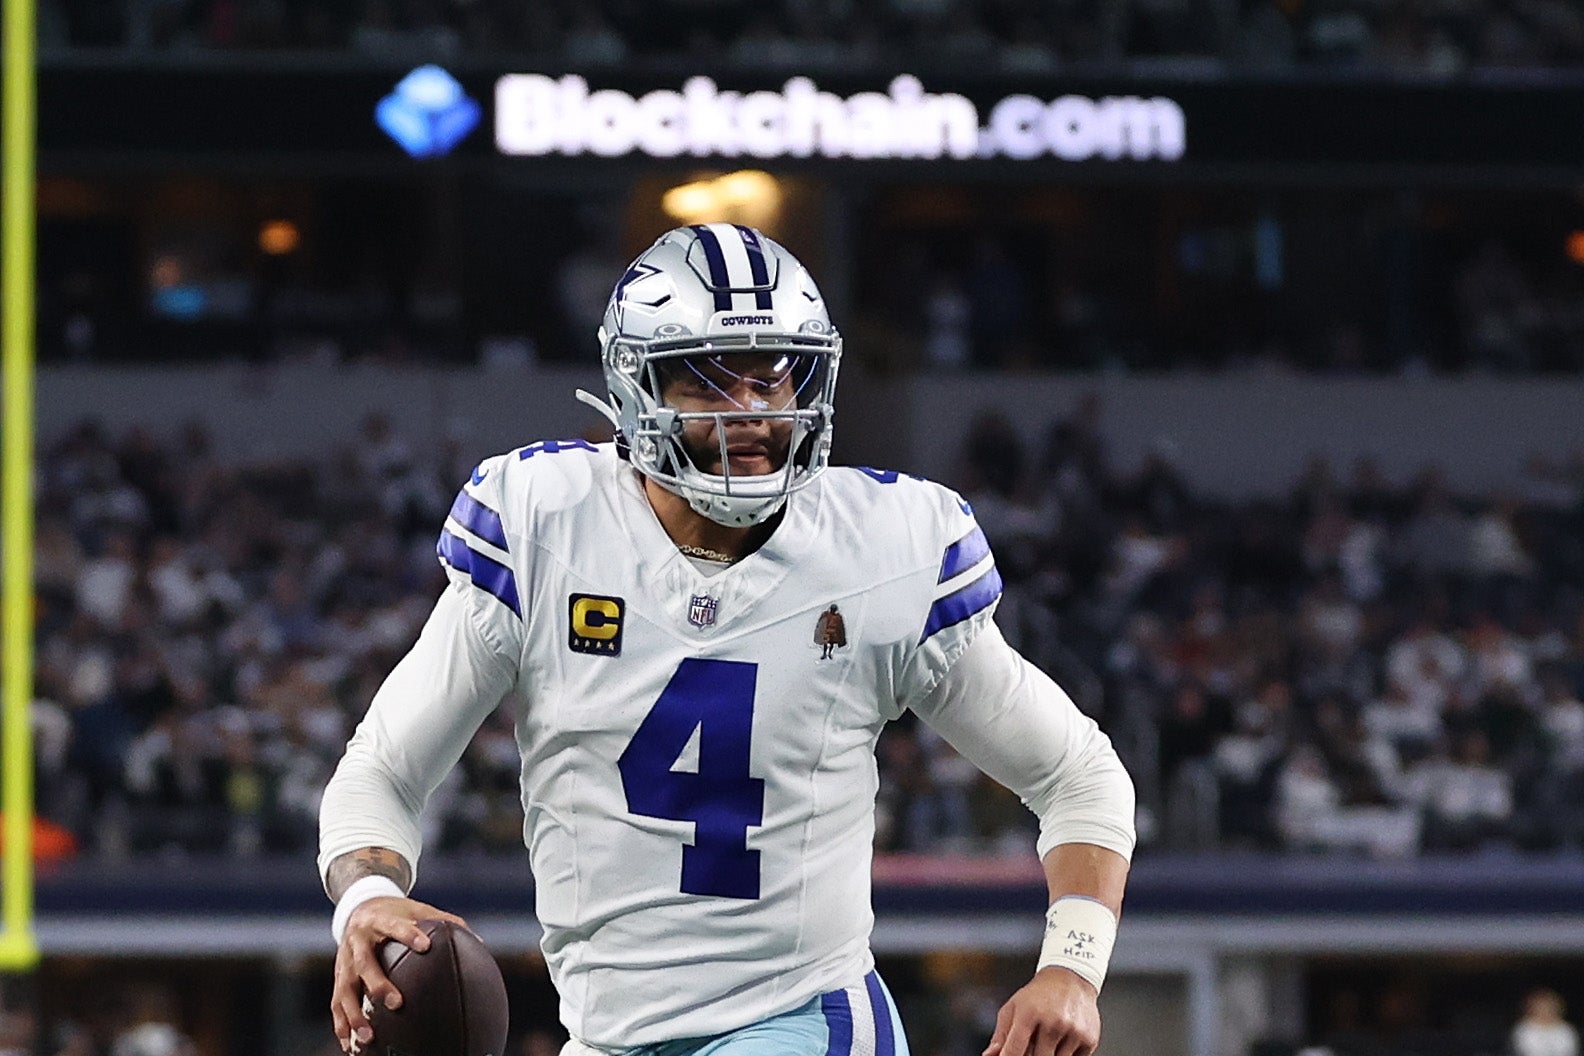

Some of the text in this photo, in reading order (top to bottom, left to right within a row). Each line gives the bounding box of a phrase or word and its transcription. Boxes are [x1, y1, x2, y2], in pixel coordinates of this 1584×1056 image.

[495, 74, 1185, 159] Blockchain.com
[721, 315, 774, 326] COWBOYS
[573, 598, 620, 639] C
[690, 605, 714, 624] NFL
[617, 657, 765, 900] 4
